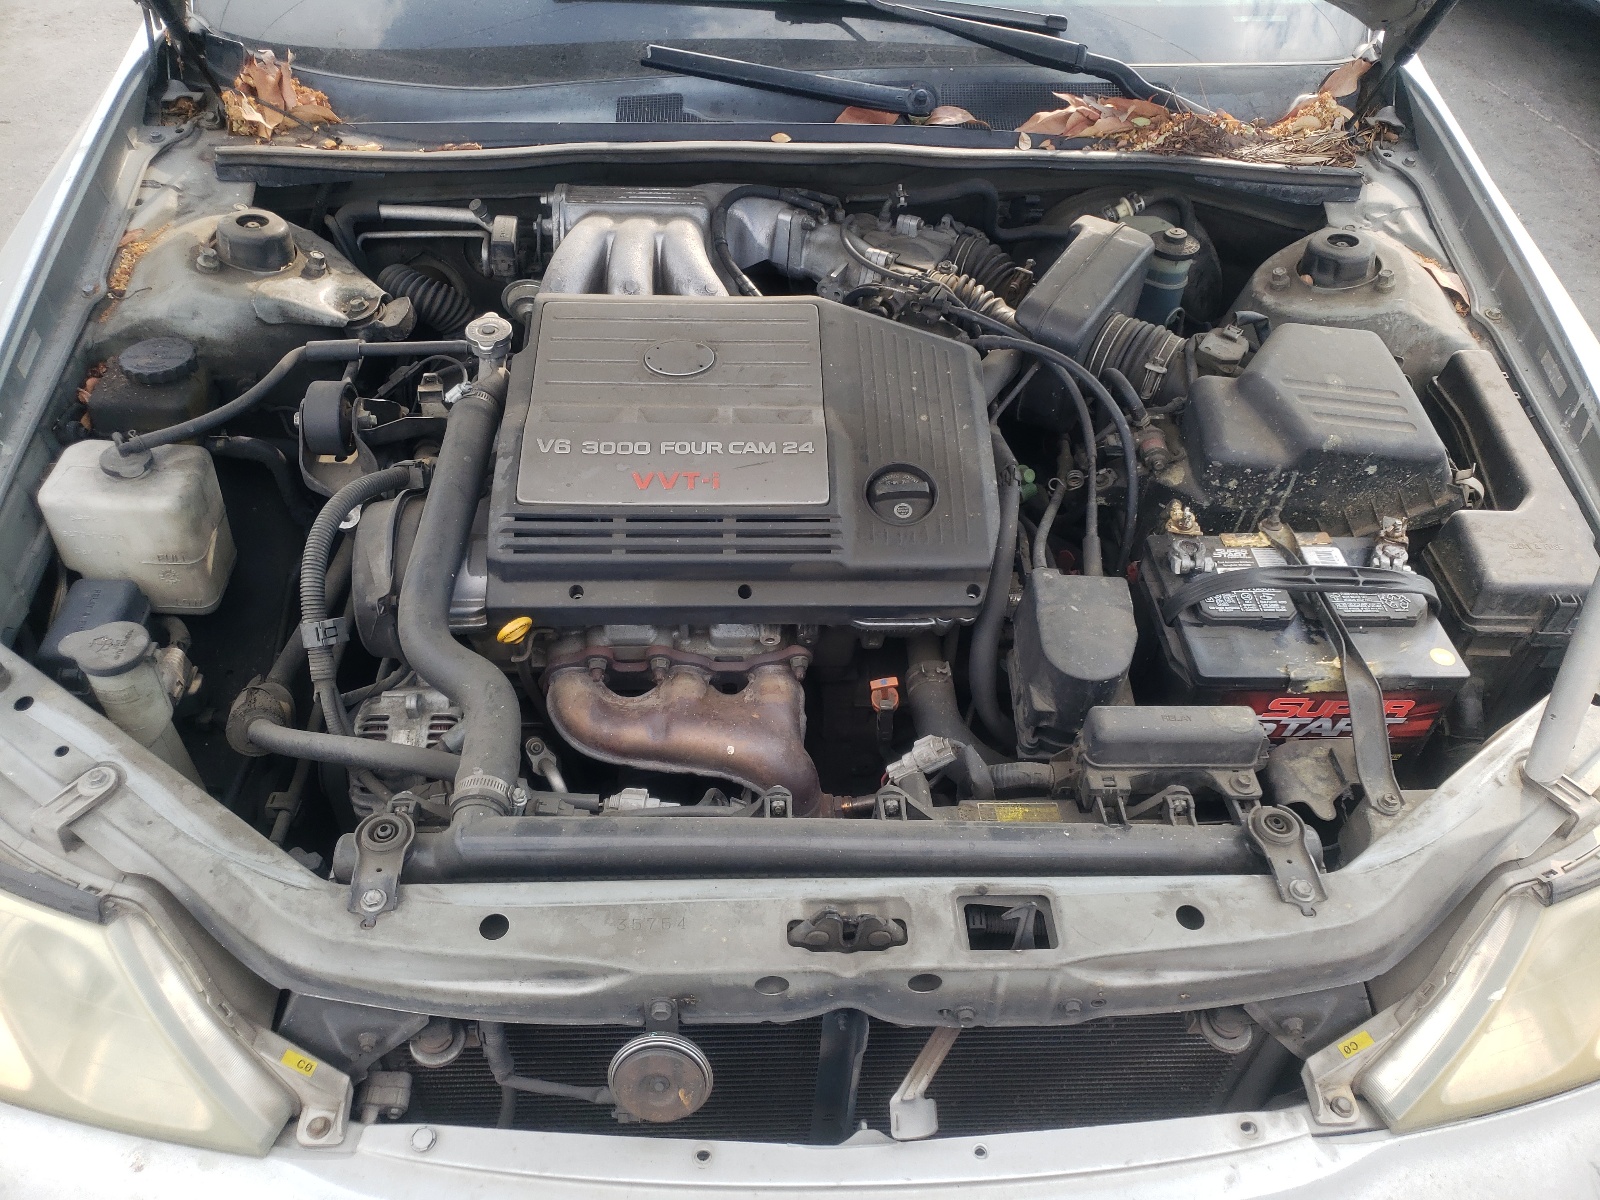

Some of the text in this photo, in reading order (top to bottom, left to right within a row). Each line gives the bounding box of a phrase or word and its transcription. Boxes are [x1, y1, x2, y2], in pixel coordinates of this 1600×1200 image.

[536, 437, 815, 455] V6 3000 FOUR CAM 24
[632, 472, 720, 490] VVT-i
[1262, 697, 1416, 718] SUPR
[1160, 714, 1193, 722] RELAY
